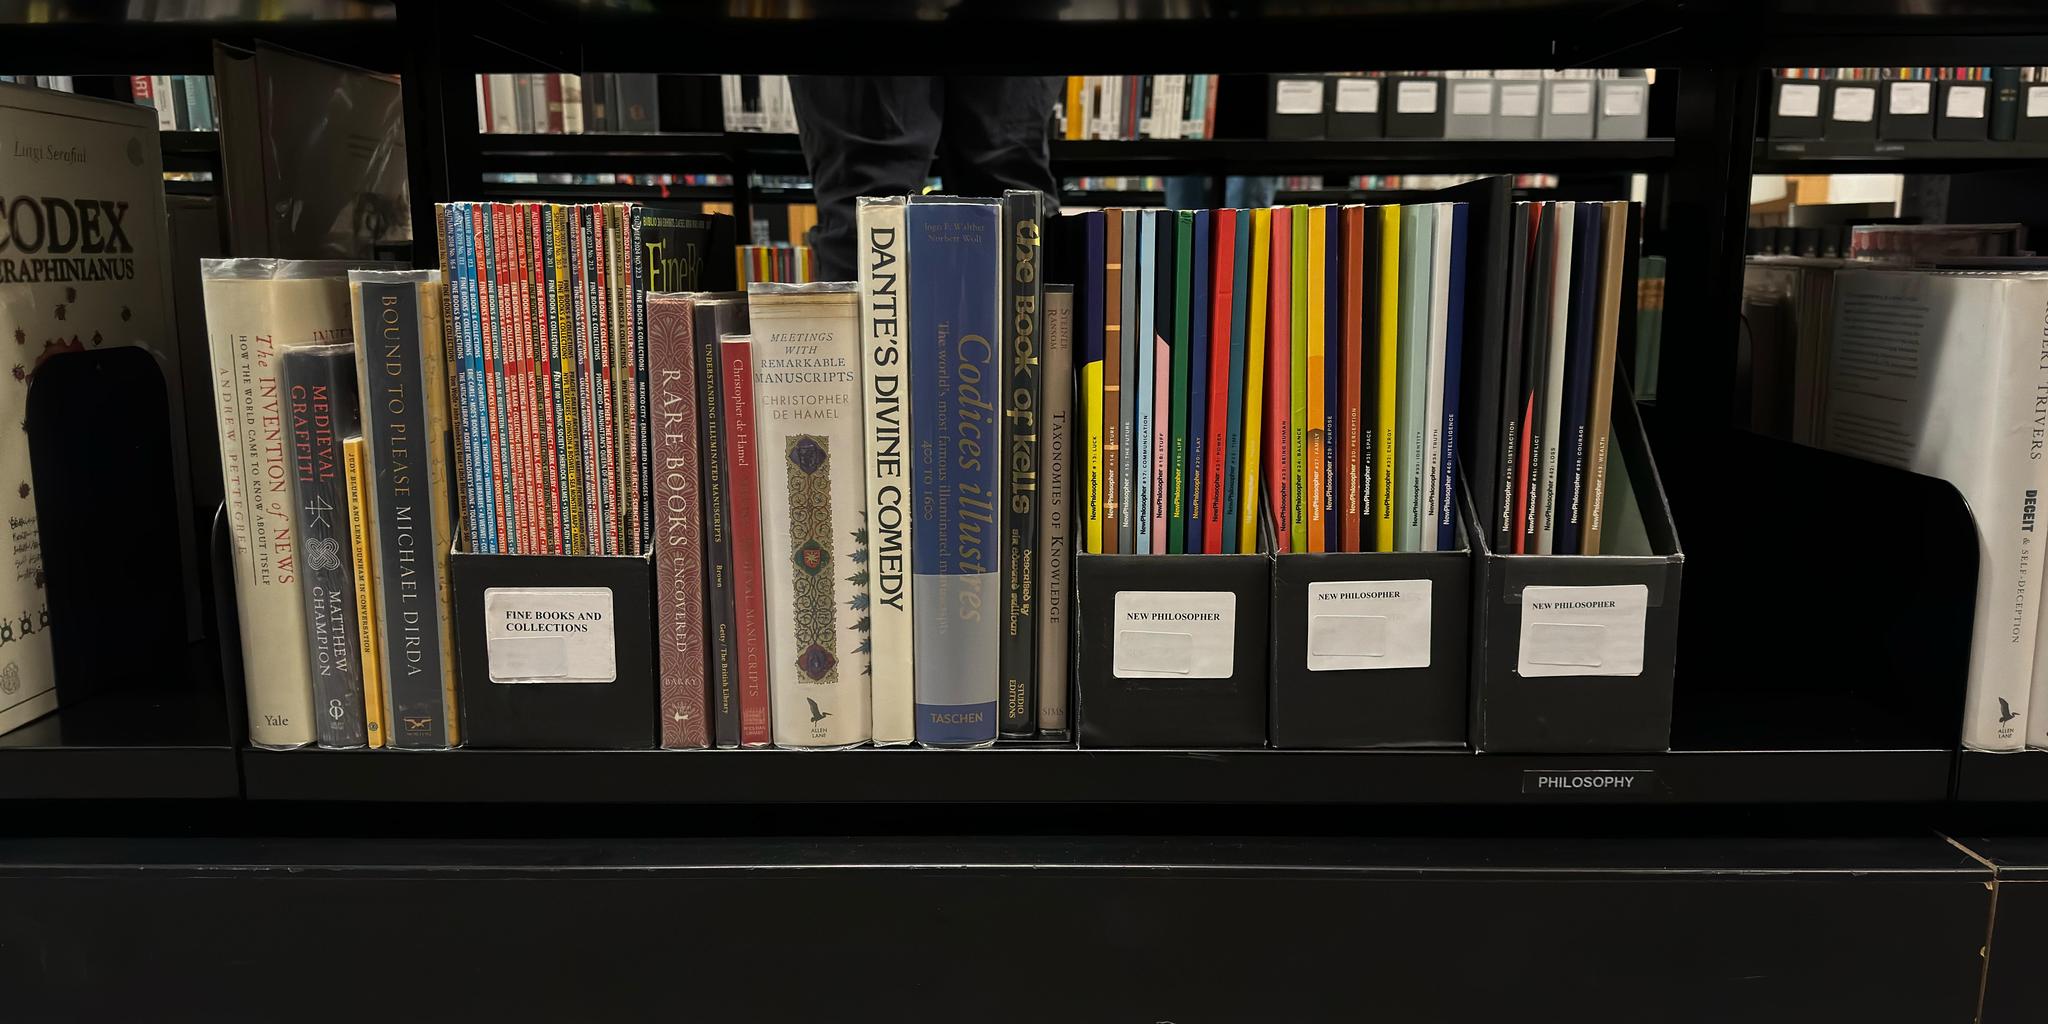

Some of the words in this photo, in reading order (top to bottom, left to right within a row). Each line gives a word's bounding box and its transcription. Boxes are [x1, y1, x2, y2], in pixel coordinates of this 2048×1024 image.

[14, 141, 43, 160] Luigi
[47, 146, 87, 167] Serafini
[0, 258, 134, 283] RAPHINIANUS
[870, 227, 900, 367] DANTE'S
[240, 335, 248, 359] HOW
[381, 296, 402, 375] BOUND
[770, 333, 834, 342] MEETINGS
[938, 321, 950, 346] The
[1048, 309, 1058, 350] RANSOM
[1060, 308, 1070, 350] STEINER
[256, 335, 275, 368] The
[761, 357, 846, 368] REMARKABLE
[785, 345, 818, 355] WITH
[243, 364, 251, 385] THE
[706, 343, 716, 419] UNDERSTANDING
[731, 359, 745, 416] Christopher
[755, 371, 856, 384] MANUSCRIPTS
[938, 351, 951, 397] world's
[245, 389, 255, 426] WORLD
[388, 384, 405, 414] TO
[663, 369, 684, 446] RARE
[764, 394, 849, 406] CHRISTOPHER
[773, 410, 789, 420] DE
[794, 409, 839, 419] HAMEL
[938, 401, 949, 431] most
[957, 335, 994, 470] Codices
[1006, 388, 1034, 426] of
[258, 378, 287, 494] INVENTION
[291, 385, 314, 482] GRAFFITI
[312, 386, 335, 483] MEDIEVAL
[736, 420, 745, 431] de
[873, 374, 901, 478] DIVINE
[2030, 382, 2048, 461] TRIVERS
[219, 368, 237, 441] ANDREW
[229, 454, 249, 556] PETTEGREE
[249, 430, 257, 459] CAME
[391, 424, 411, 497] PLEASE
[709, 422, 719, 481] ILLUMINATED
[737, 434, 749, 466] Hamel
[921, 441, 934, 464] 400
[938, 436, 950, 481] famous
[1052, 411, 1067, 505] TAXONOMIES
[252, 462, 259, 476] TO
[1011, 434, 1038, 514] kells
[254, 480, 262, 511] KNOW
[267, 503, 289, 523] of
[667, 457, 688, 546] BOOKS
[712, 483, 722, 543] MANUSCRIPTS
[1140, 486, 1148, 535] NewPhilosopher
[1193, 470, 1201, 518] NewPhilosopher
[1443, 475, 1452, 525] NewPhilosopher
[1528, 483, 1537, 534] NewPhilosopher
[1571, 473, 1581, 524] NewPhilosopher
[2022, 489, 2039, 533] DECEIT
[256, 515, 265, 549] ABOUT
[939, 485, 951, 556] illuminated
[1051, 511, 1060, 529] OF
[274, 528, 295, 584] NEWS
[350, 477, 358, 504] BLUME
[355, 547, 364, 581] DUNHAM
[360, 596, 370, 653] CONVERSATION
[396, 507, 417, 602] MICHAEL
[877, 485, 905, 613] COMEDY
[958, 484, 994, 621] illustres
[259, 553, 269, 586] ITSELF
[716, 564, 724, 588] Brown
[1049, 536, 1065, 624] KNOWLEDGE
[506, 610, 532, 620] FINE
[535, 611, 574, 621] BOOKS
[577, 611, 602, 621] AND
[674, 558, 687, 653] UNCOVERED
[1318, 593, 1338, 601] NEW
[1340, 591, 1400, 600] PHILOSOPHER
[1532, 602, 1551, 610] NEW
[1554, 600, 1615, 609] PHILOSOPHER
[2012, 549, 2029, 643] SELF-DECEPTION
[312, 587, 331, 676] CHAMPION
[329, 591, 348, 673] MATTHEW
[506, 622, 588, 632] COLLECTIONS
[719, 624, 728, 642] Getty
[1127, 613, 1149, 621] NEW
[1151, 612, 1220, 621] PHILOSOPHER
[403, 611, 423, 676] DIRDA
[720, 649, 728, 662] The
[745, 609, 760, 697] MANUSCRIPTS
[721, 663, 729, 687] British
[722, 689, 731, 714] Library
[930, 712, 983, 724] TASCHEN
[1008, 679, 1017, 719] EDITIONS
[1017, 683, 1025, 714] STUDIO
[1042, 708, 1063, 716] SIMS
[265, 714, 288, 726] Yale
[1538, 776, 1634, 788] PHILOSOPHY
